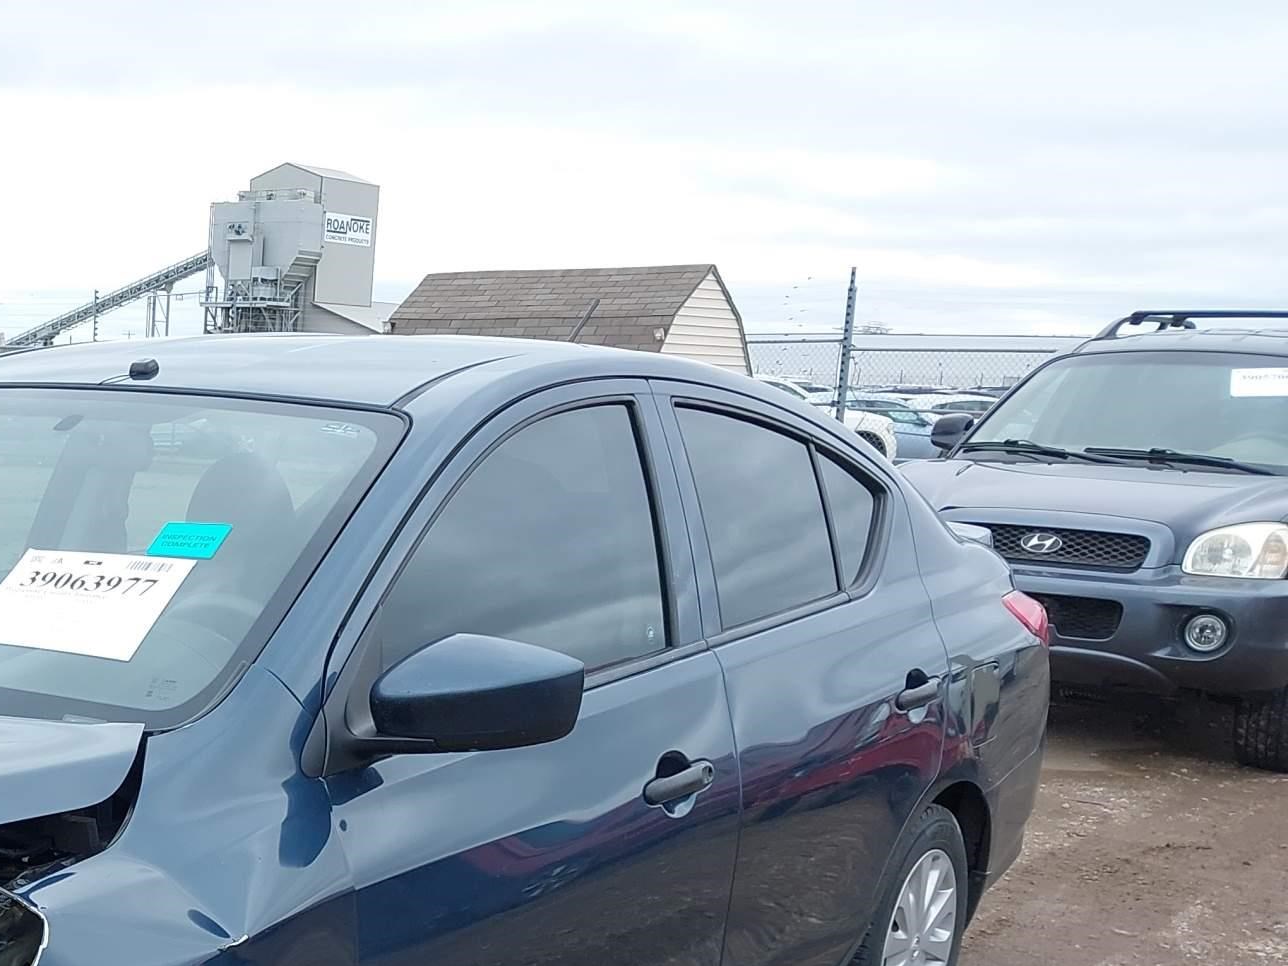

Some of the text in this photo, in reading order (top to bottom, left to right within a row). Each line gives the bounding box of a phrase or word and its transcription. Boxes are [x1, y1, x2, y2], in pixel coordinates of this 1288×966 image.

[326, 218, 370, 234] ROANOKE
[326, 234, 369, 245] CONCRETE PRODUCTS
[161, 534, 217, 542] INSPECTION
[160, 541, 210, 549] COMPLETE
[19, 570, 159, 597] 39063977
